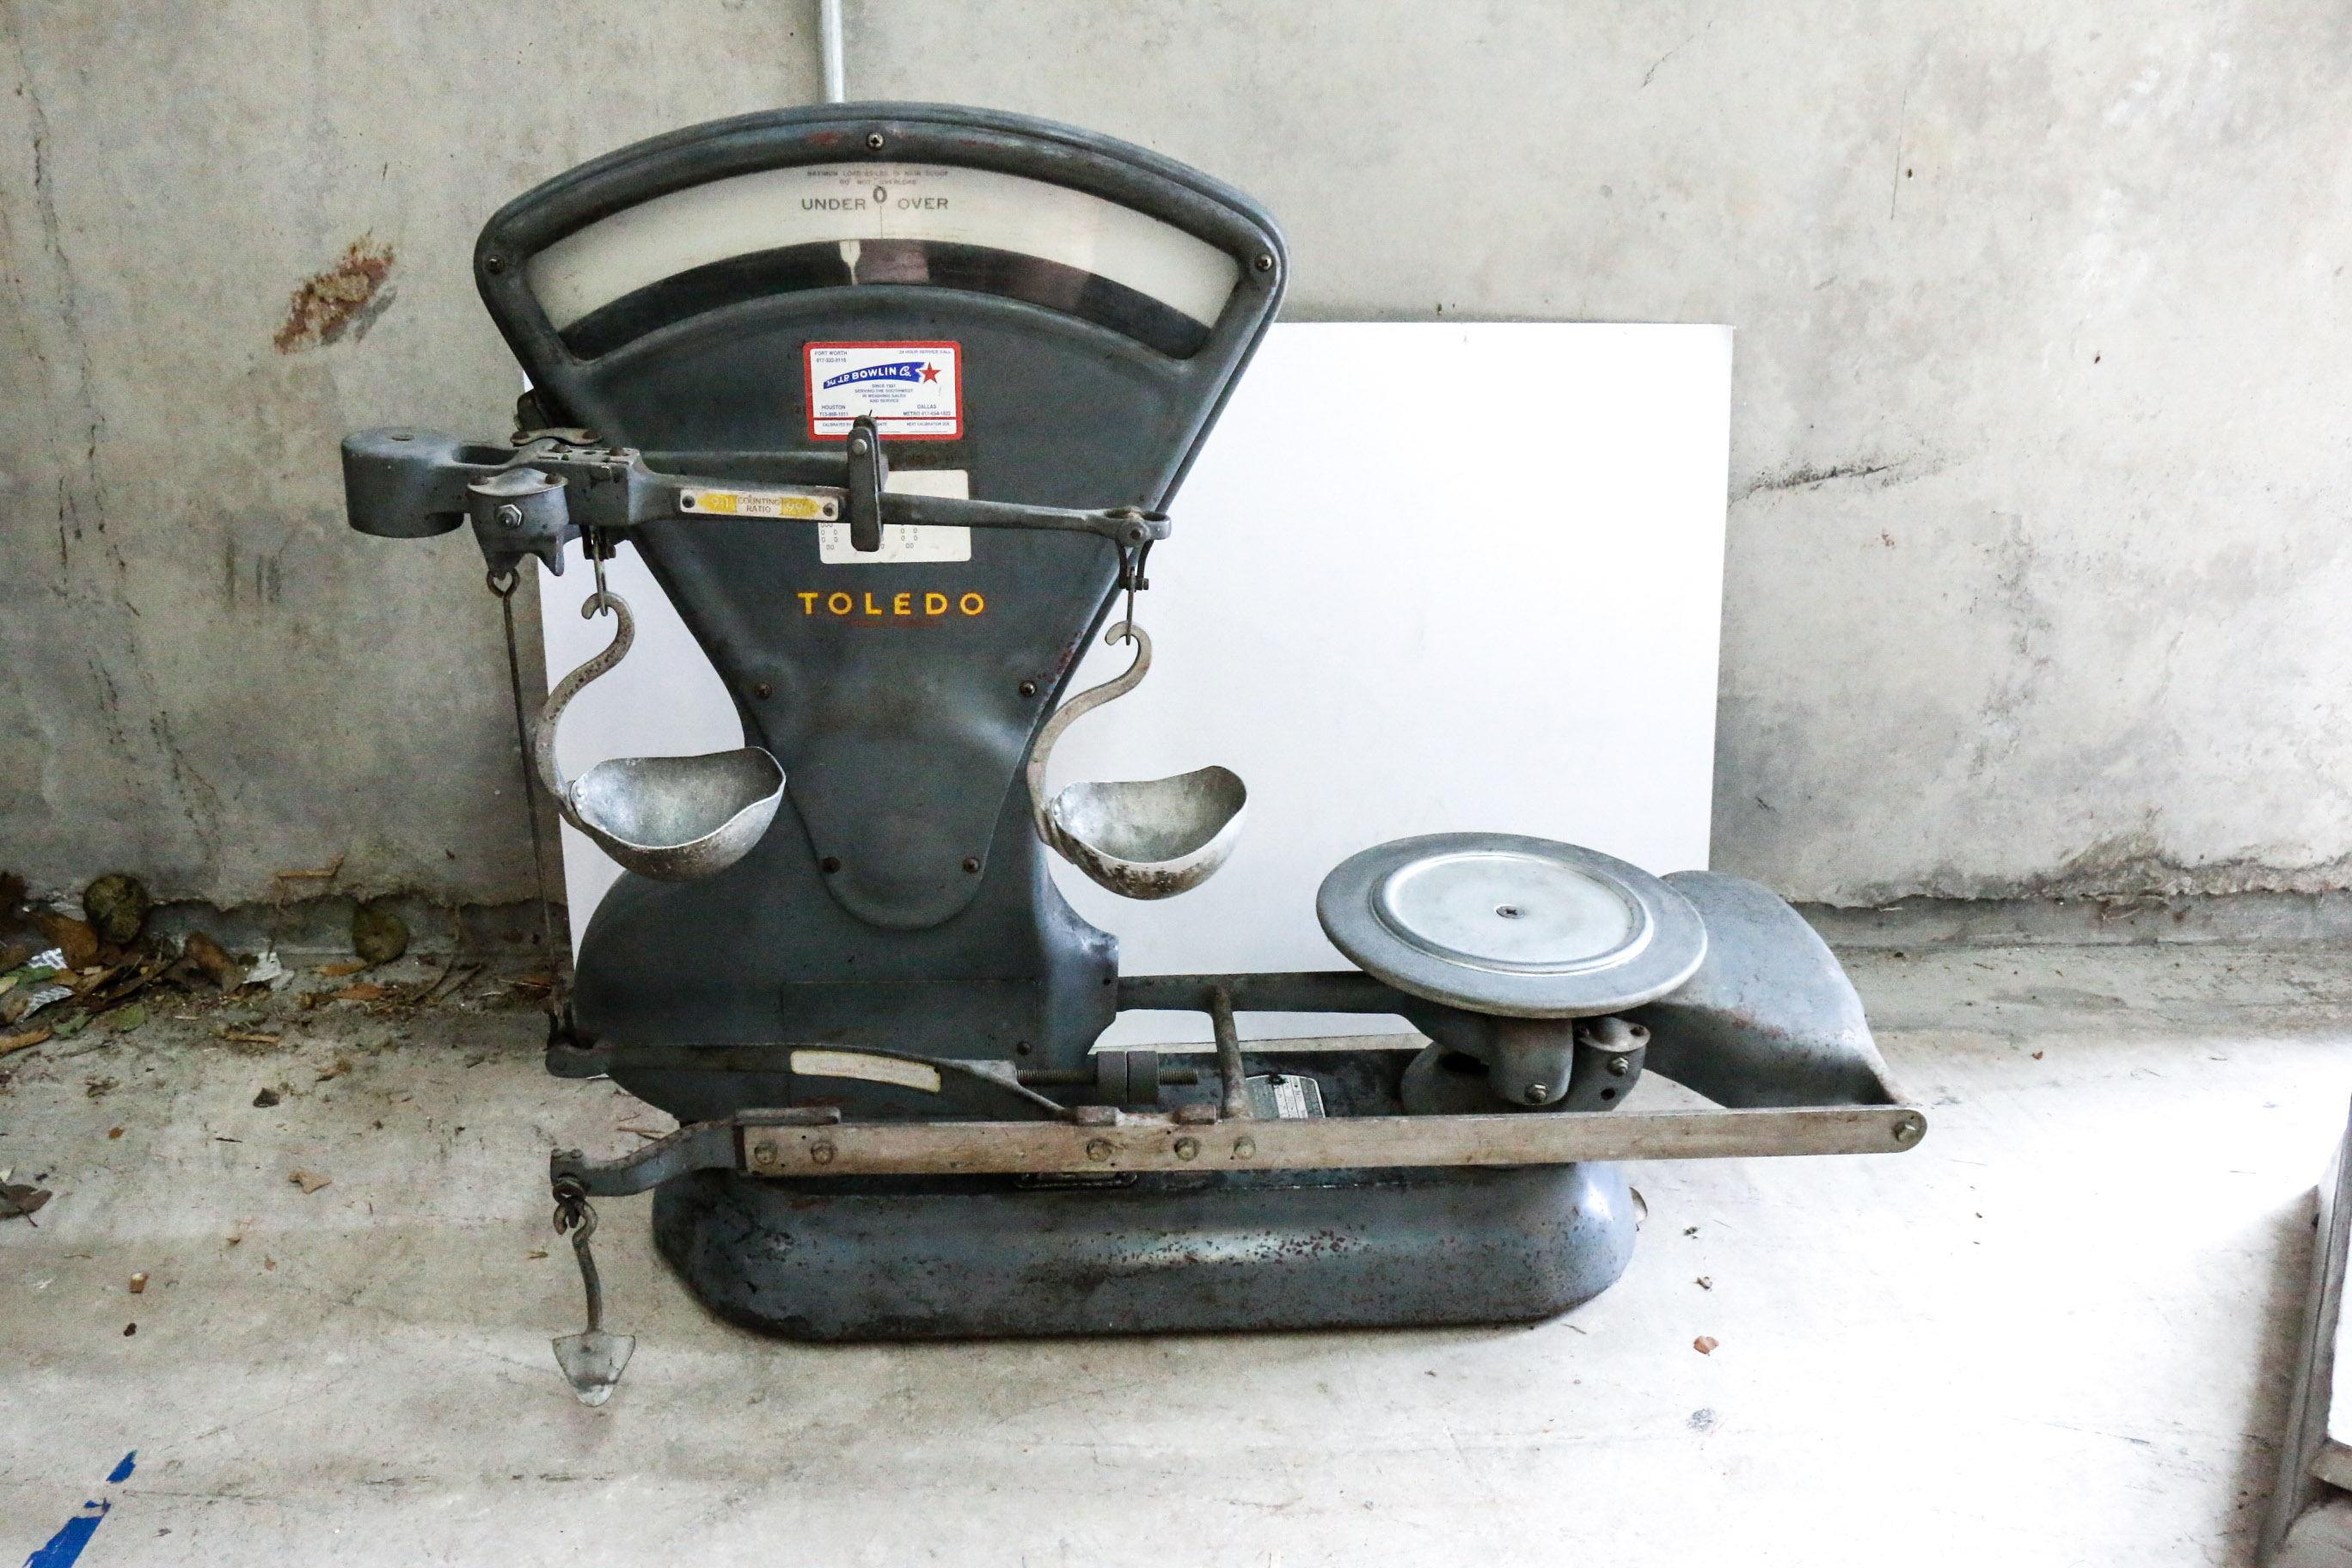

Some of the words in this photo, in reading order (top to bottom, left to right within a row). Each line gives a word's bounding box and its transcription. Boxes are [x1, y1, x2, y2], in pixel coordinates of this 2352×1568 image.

[801, 198, 867, 211] UNDER
[873, 186, 888, 204] 0
[897, 198, 949, 210] OVER
[851, 366, 897, 380] BOWLIN
[898, 365, 912, 377] Co.
[738, 495, 782, 506] COUNTING
[797, 591, 985, 616] TOLEDO
